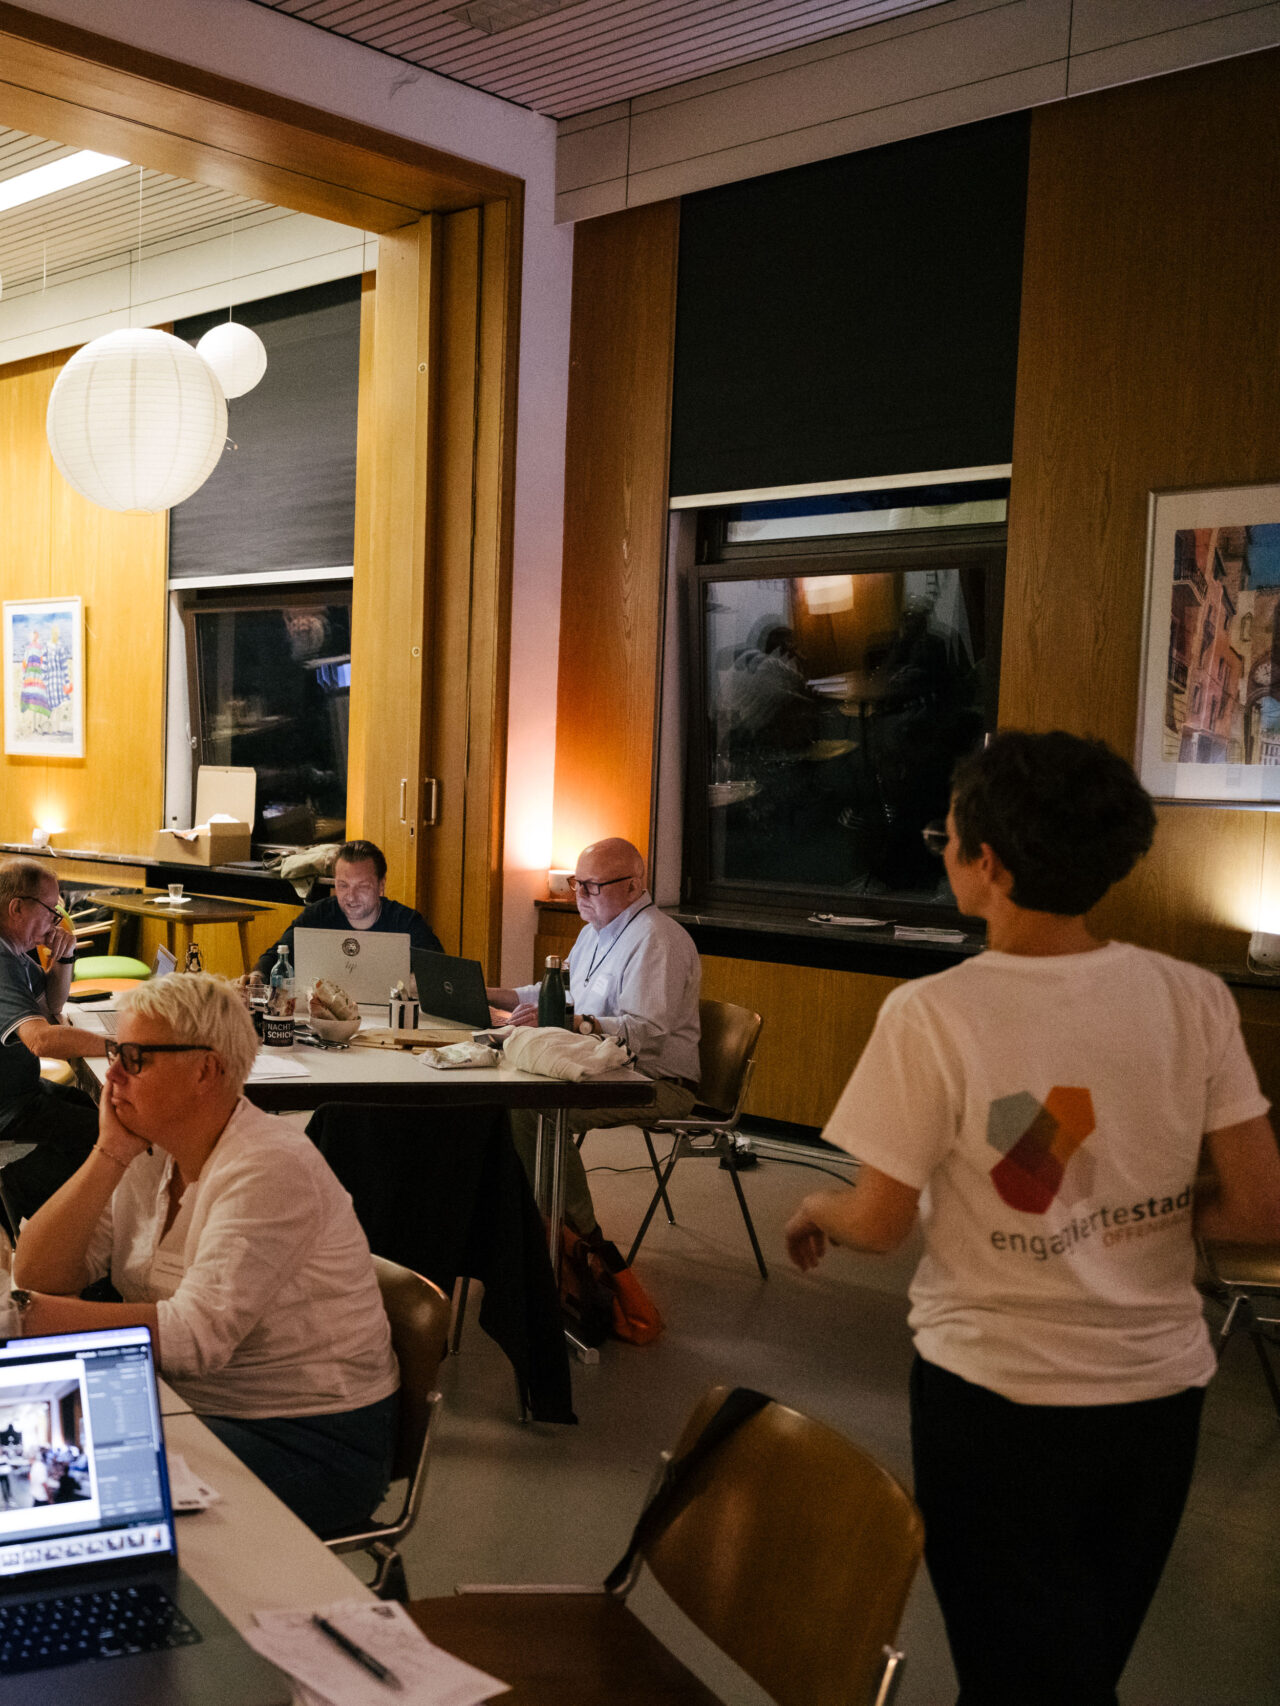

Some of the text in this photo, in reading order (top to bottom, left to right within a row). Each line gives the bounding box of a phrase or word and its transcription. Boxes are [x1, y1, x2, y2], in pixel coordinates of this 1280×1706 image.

[267, 1023, 291, 1031] NACHT
[267, 1030, 294, 1039] SCHIC
[991, 1185, 1190, 1262] engaiertestad
